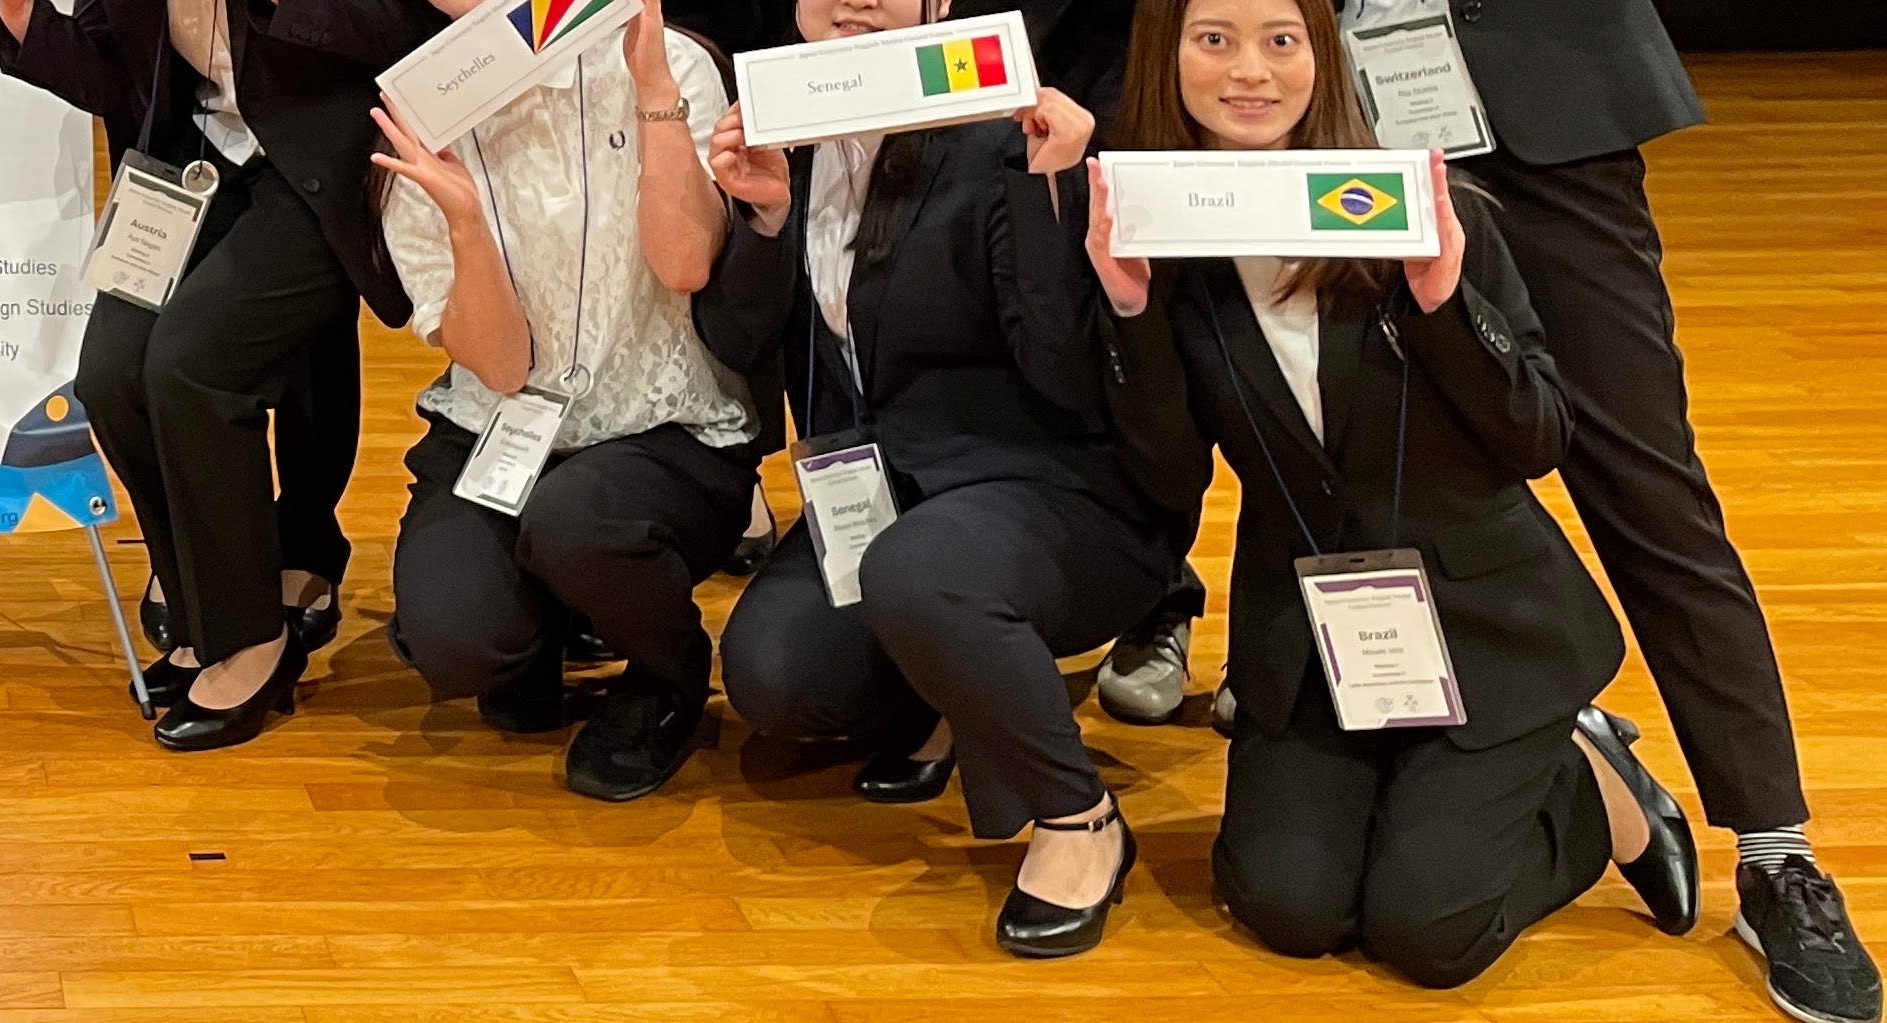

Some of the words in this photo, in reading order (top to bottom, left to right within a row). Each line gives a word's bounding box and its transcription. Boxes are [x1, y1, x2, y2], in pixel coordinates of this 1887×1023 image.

[436, 51, 497, 96] Seychelles
[807, 73, 864, 95] Senegal
[1375, 62, 1452, 85] Switzerland
[1188, 191, 1236, 208] Brazil
[130, 219, 168, 240] Austria
[26, 298, 94, 316] Studies
[1358, 628, 1398, 642] Brazil
